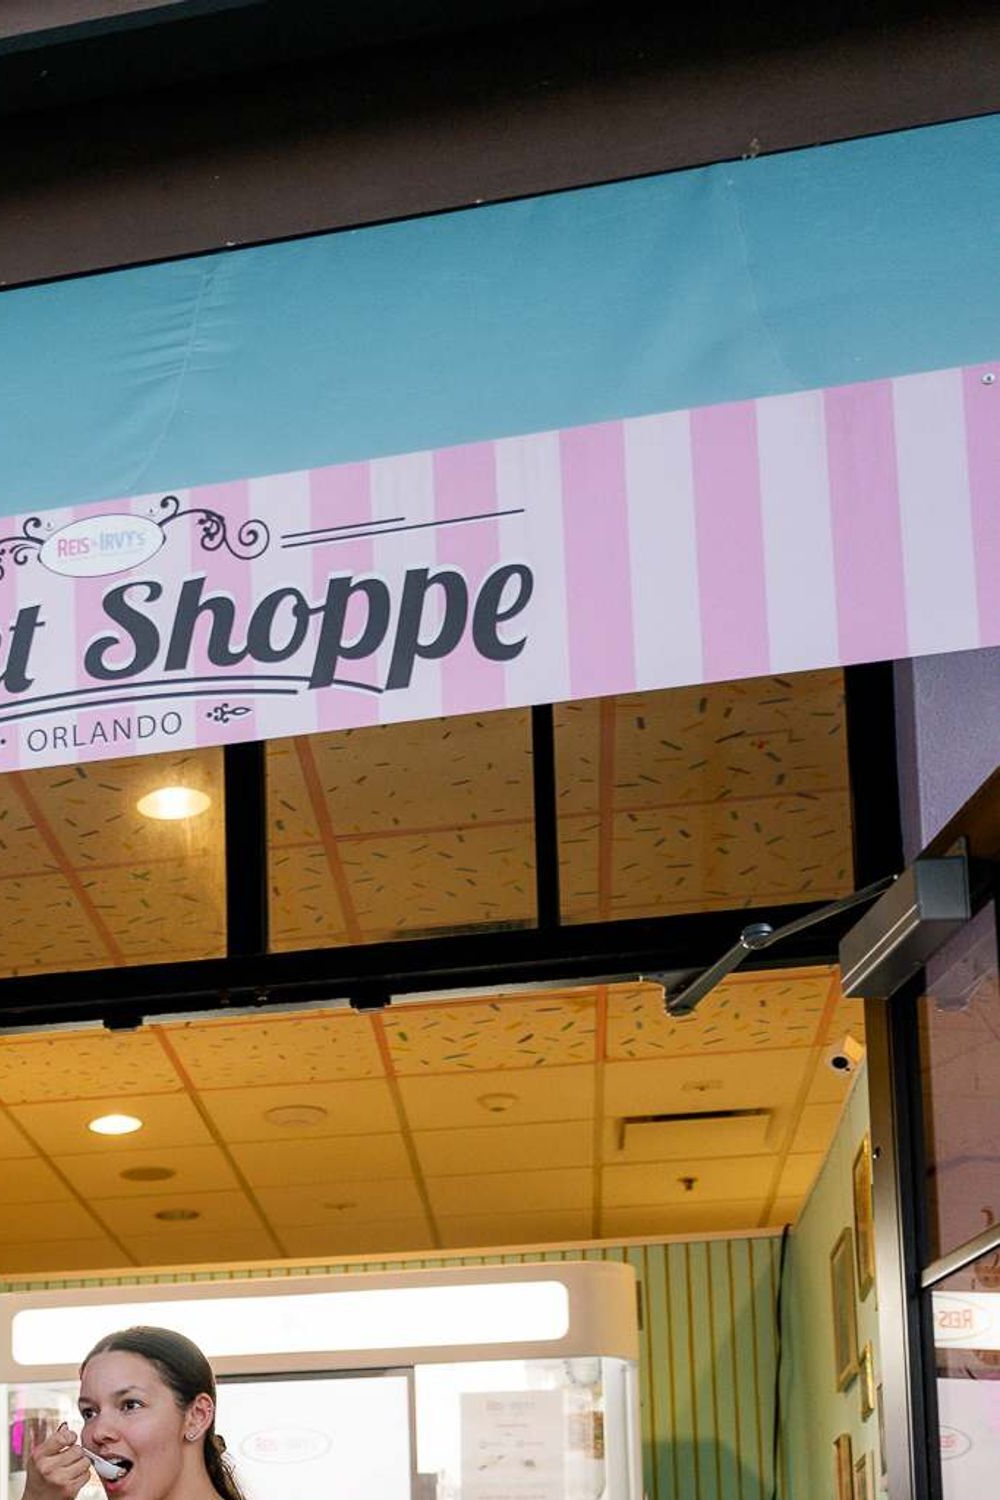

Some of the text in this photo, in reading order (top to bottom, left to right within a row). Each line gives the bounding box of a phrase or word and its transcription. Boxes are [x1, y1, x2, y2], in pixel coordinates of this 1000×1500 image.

[57, 537, 90, 557] REIS
[84, 563, 534, 691] Shoppe
[27, 711, 183, 752] ORLANDO
